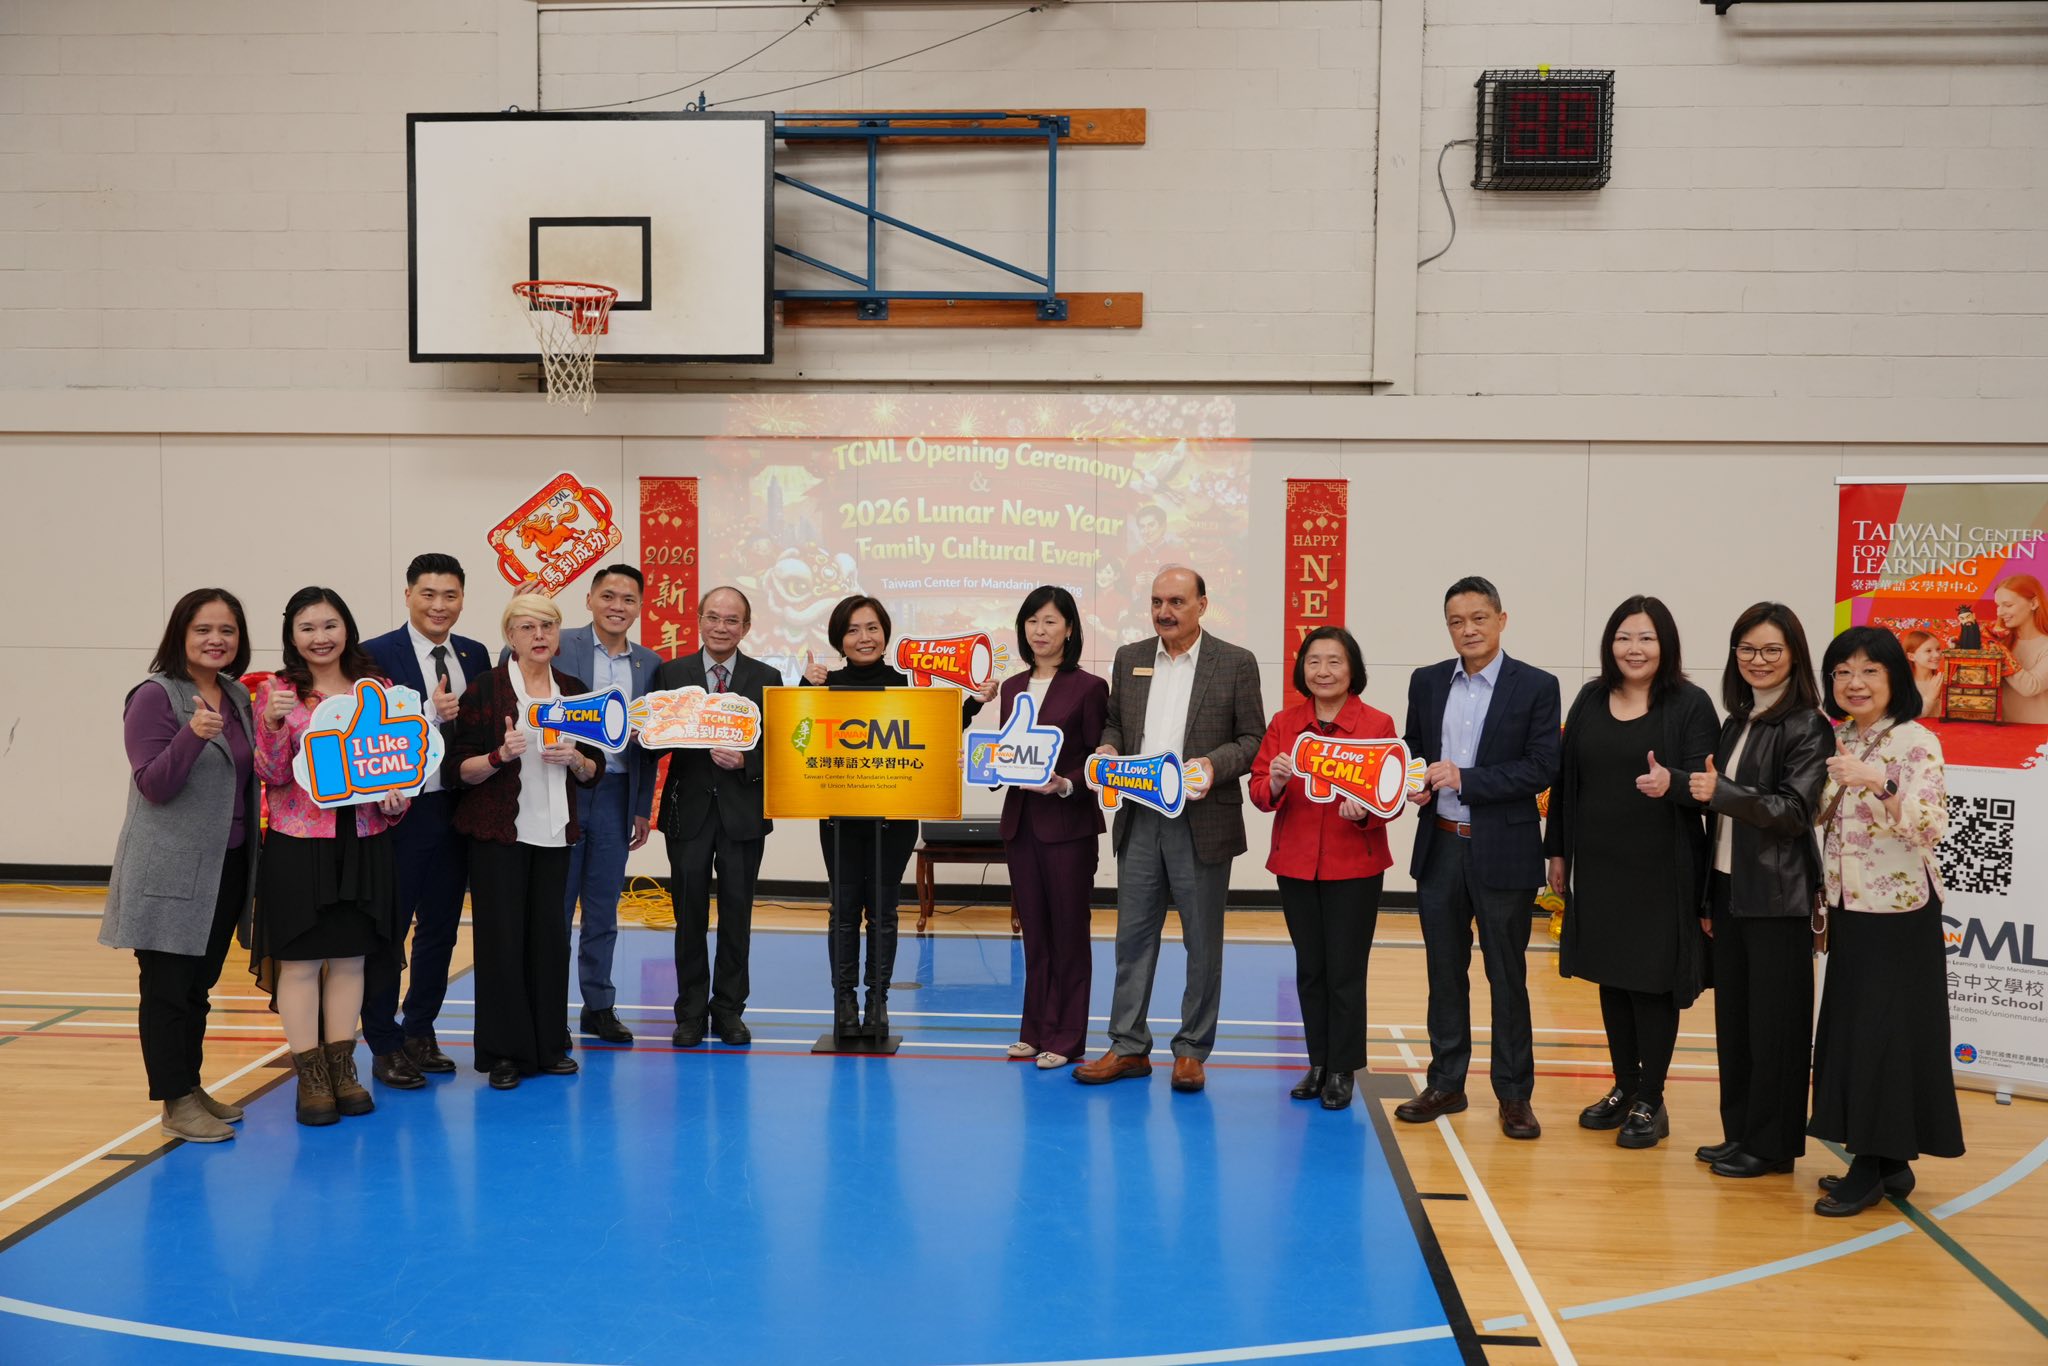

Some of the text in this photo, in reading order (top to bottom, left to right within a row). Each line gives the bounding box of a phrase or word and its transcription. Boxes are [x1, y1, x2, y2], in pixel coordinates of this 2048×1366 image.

[832, 437, 1132, 489] TCML Opening Ceremony
[970, 470, 991, 493] &
[544, 490, 571, 511] TCML
[839, 497, 1124, 537] 2026 Lunar New Year
[1292, 534, 1339, 547] HAPPY
[1852, 519, 2045, 543] TAIWAN CENTER
[541, 531, 608, 589] 馬到成功
[643, 545, 696, 566] 2026
[856, 535, 1102, 568] Family Cultural Event
[1852, 540, 2036, 560] FOR MANDARIN
[1852, 556, 1978, 577] LEARNING
[881, 577, 922, 590] Taiwan
[924, 577, 960, 589] Center
[963, 576, 978, 588] for
[981, 577, 1034, 591] Mandarin
[1851, 579, 1979, 593] 臺灣華語文學習中心
[651, 573, 689, 660] 新年
[917, 641, 957, 655] I Love
[909, 653, 961, 673] TCML
[565, 709, 602, 722] TCML
[703, 713, 735, 725] TCML
[352, 733, 409, 757] I Like
[815, 719, 926, 750] TCML
[805, 756, 924, 770] 臺灣華語文學習中心
[985, 743, 1045, 766] TCML
[1320, 743, 1365, 763] I Love
[353, 753, 414, 778] TCML
[1115, 761, 1148, 775] I Love
[1310, 756, 1367, 785] TCML
[1105, 773, 1154, 791] TAIWAN
[1952, 960, 1978, 969] Learning
[1991, 995, 2043, 1011] School
